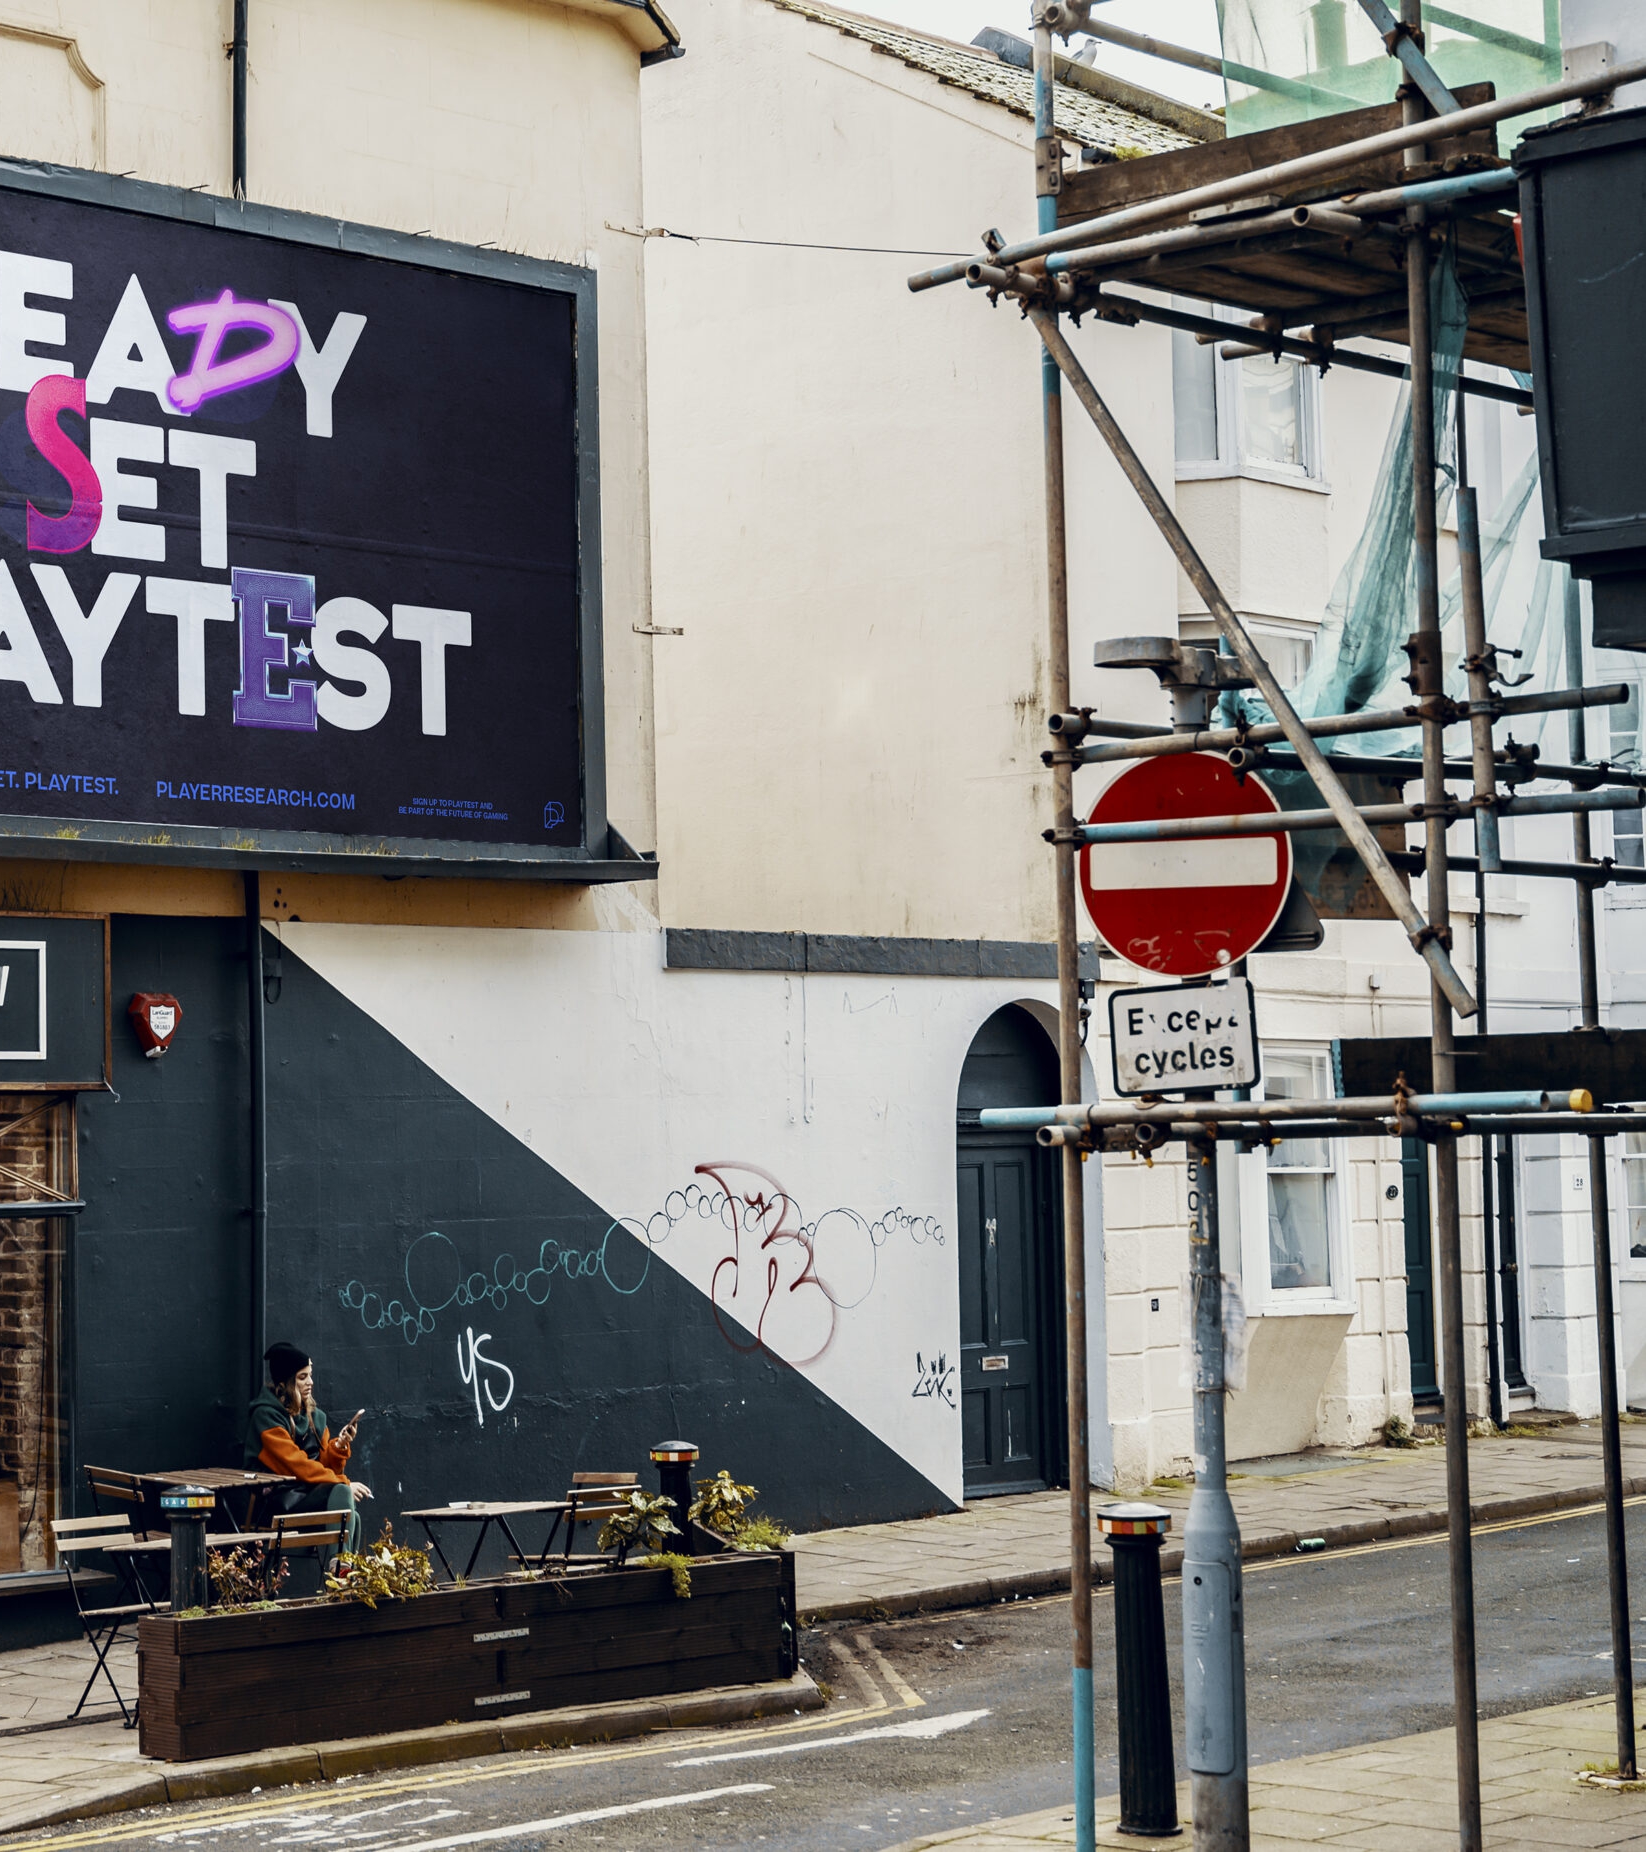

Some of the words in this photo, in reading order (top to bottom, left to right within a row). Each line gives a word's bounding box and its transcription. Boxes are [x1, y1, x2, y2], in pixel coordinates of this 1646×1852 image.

[25, 373, 258, 570] SET
[24, 773, 120, 795] PLAYTEST.
[156, 780, 355, 810] PLAYERRESEARCH.COM
[398, 806, 407, 814] BE
[408, 807, 425, 816] PART
[425, 808, 435, 816] OF
[435, 809, 448, 817] THE
[448, 810, 473, 819] FUTURE
[473, 811, 483, 819] OF
[483, 812, 509, 821] GAMING
[412, 797, 429, 805] SIGN
[439, 799, 447, 807] TO
[447, 800, 479, 810] PLAYTEST
[479, 802, 493, 810] AND
[1134, 1041, 1235, 1079] cycles
